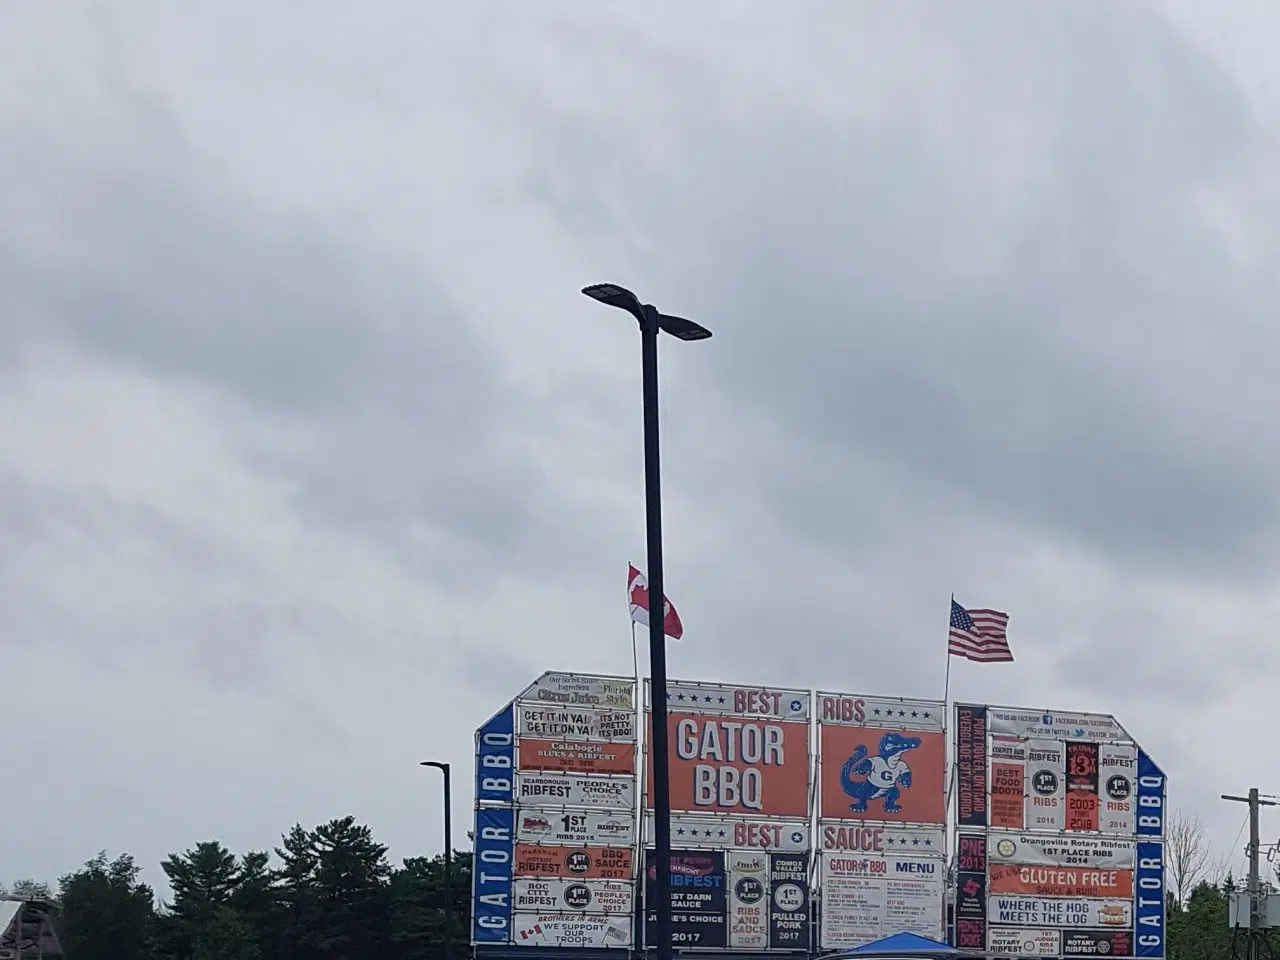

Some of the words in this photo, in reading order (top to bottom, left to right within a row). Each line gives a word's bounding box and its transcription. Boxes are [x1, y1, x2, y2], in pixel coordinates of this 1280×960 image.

[603, 684, 631, 695] Florida
[538, 689, 570, 703] Citrus
[571, 692, 599, 704] Juice
[606, 695, 627, 703] Style
[734, 689, 782, 715] BEST
[824, 698, 865, 722] RIBS
[525, 711, 546, 720] GET
[547, 713, 557, 721] IT
[559, 714, 568, 722] IN
[569, 714, 587, 724] YA!
[527, 723, 548, 731] GET
[550, 724, 561, 733] IT
[563, 725, 575, 733] ON
[577, 726, 593, 735] YA!
[613, 728, 632, 736] BBQ!
[973, 718, 985, 741] PORT
[960, 710, 972, 761] EVERGLADE
[551, 742, 602, 751] Calabogie
[678, 718, 784, 765] GATOR
[482, 732, 512, 793] BBQ
[1029, 753, 1061, 763] RIBFEST
[1103, 758, 1133, 768] RIBFEST
[881, 771, 893, 781] G
[960, 761, 972, 782] CITY
[996, 768, 1020, 776] BEST
[576, 780, 628, 789] PEOPLE'S
[996, 778, 1020, 786] FOOD
[1040, 775, 1052, 784] 1ST
[1113, 779, 1125, 789] 1ST
[522, 785, 571, 798] RIBFEST
[694, 764, 762, 811] BBQ
[992, 785, 1023, 795] BOOTH
[973, 775, 985, 812] ONTARIO
[960, 783, 972, 818] FLORIDA
[1033, 797, 1057, 807] RIBS
[1070, 799, 1095, 810] 2003
[1140, 776, 1163, 828] BBQ
[1107, 802, 1130, 811] RIBS
[561, 815, 586, 832] 1ST
[1071, 819, 1092, 829] 2018
[734, 822, 783, 848] BEST
[824, 826, 884, 852] SAUCE
[960, 839, 985, 856] PNE
[1020, 837, 1068, 847] Orangeville
[1071, 840, 1099, 849] Rotary
[1101, 841, 1130, 849] Ribfest
[602, 850, 623, 859] BBQ
[1061, 849, 1091, 857] PLACE
[572, 855, 586, 864] 1ST
[595, 859, 630, 868] SAUCE
[961, 857, 985, 869] 2013
[518, 862, 561, 873] RIBFEST
[830, 859, 858, 871] GATOR
[870, 860, 887, 873] BBQ
[896, 862, 935, 874] MENU
[478, 826, 510, 929] GATOR
[601, 869, 623, 877] 2017
[772, 872, 806, 880] RIBFEST
[991, 872, 1006, 881] WE
[1020, 868, 1077, 885] GLUTEN
[1082, 871, 1117, 887] FREE
[571, 888, 586, 897] 1ST
[743, 882, 758, 893] 1ST
[1036, 887, 1065, 895] SAUCE
[783, 889, 797, 899] 1ST
[519, 896, 557, 906] RIBFEST
[998, 900, 1038, 910] WHERE
[1042, 902, 1062, 912] THE
[1066, 903, 1089, 913] HOG
[1139, 858, 1161, 946] GATOR
[737, 907, 760, 916] RIBS
[772, 913, 806, 921] PULLED
[1000, 911, 1038, 921] MEETS
[1042, 913, 1062, 923] THE
[1066, 914, 1087, 924] LOG
[732, 926, 765, 934] SAUCE
[672, 933, 700, 941] 2017
